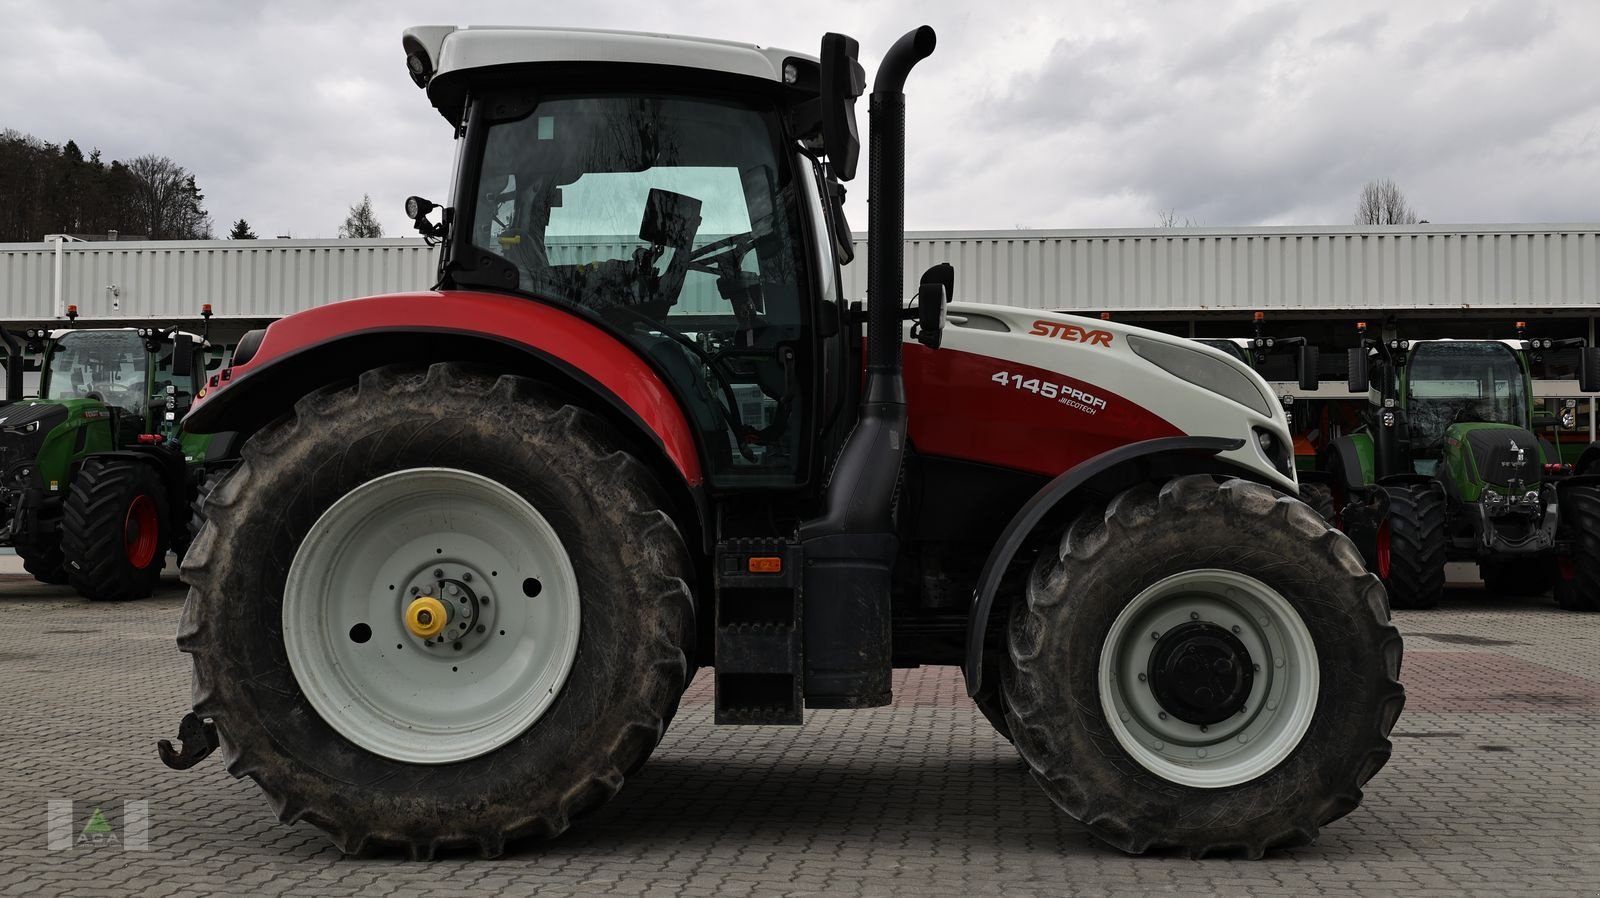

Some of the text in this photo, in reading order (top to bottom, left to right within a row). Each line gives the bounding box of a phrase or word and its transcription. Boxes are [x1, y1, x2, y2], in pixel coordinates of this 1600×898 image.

[1029, 320, 1114, 348] STEYR
[991, 371, 1107, 410] 4145 PROFI
[1066, 399, 1097, 416] ECOTECH
